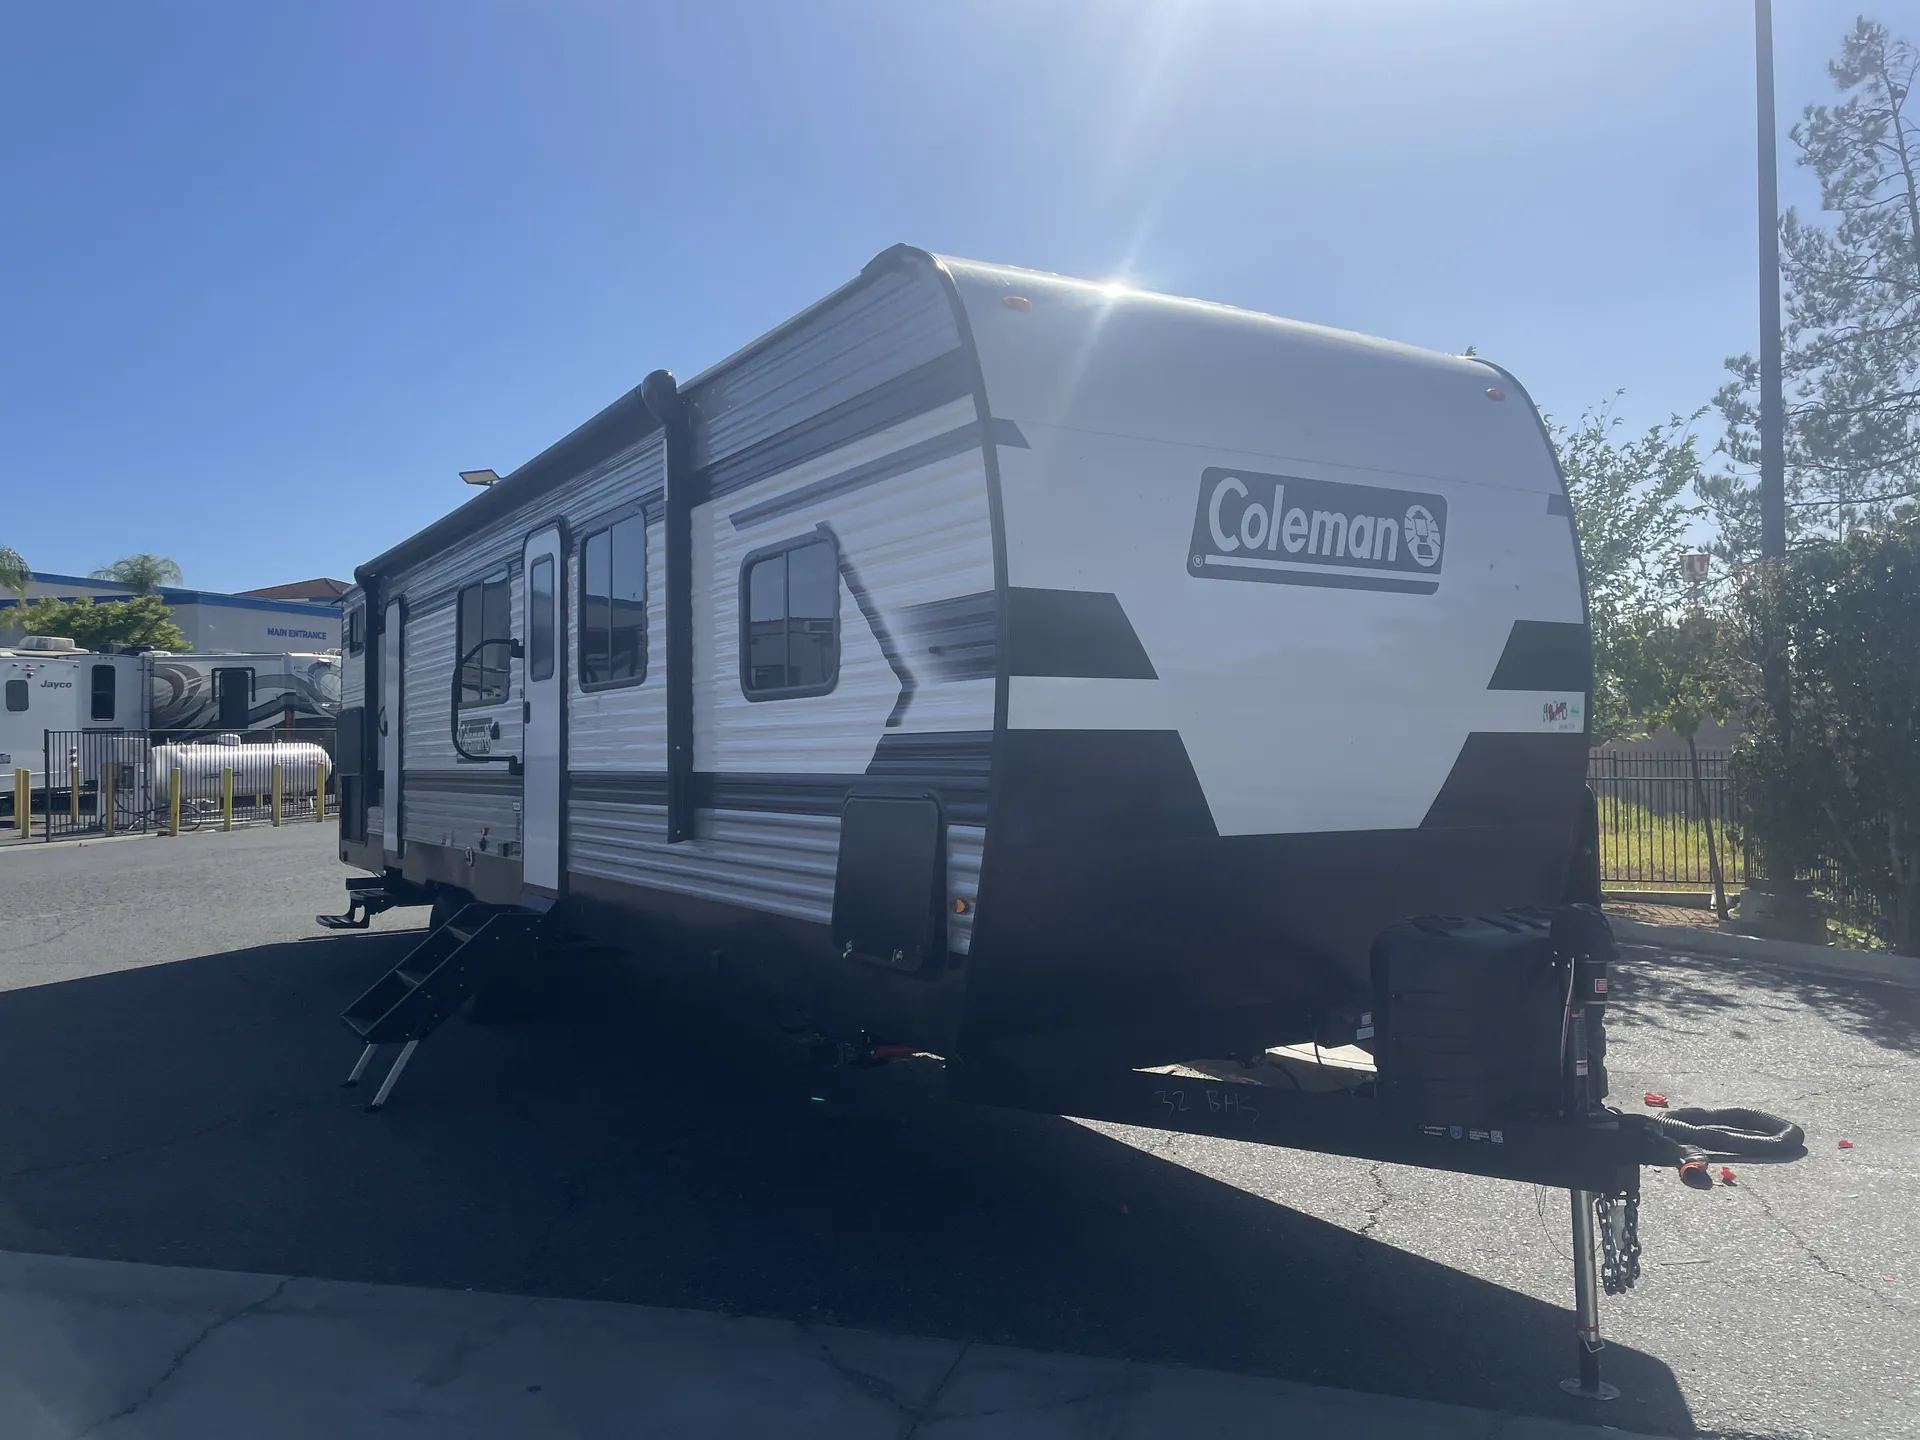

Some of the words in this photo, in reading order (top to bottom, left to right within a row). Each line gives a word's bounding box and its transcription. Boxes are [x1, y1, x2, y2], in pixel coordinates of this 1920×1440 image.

[1209, 477, 1399, 561] Coleman
[267, 627, 288, 637] MAIN
[289, 629, 327, 640] ENTRANCE
[40, 679, 72, 690] Jayco
[1153, 1090, 1192, 1117] 32
[1206, 1090, 1260, 1123] BHS
